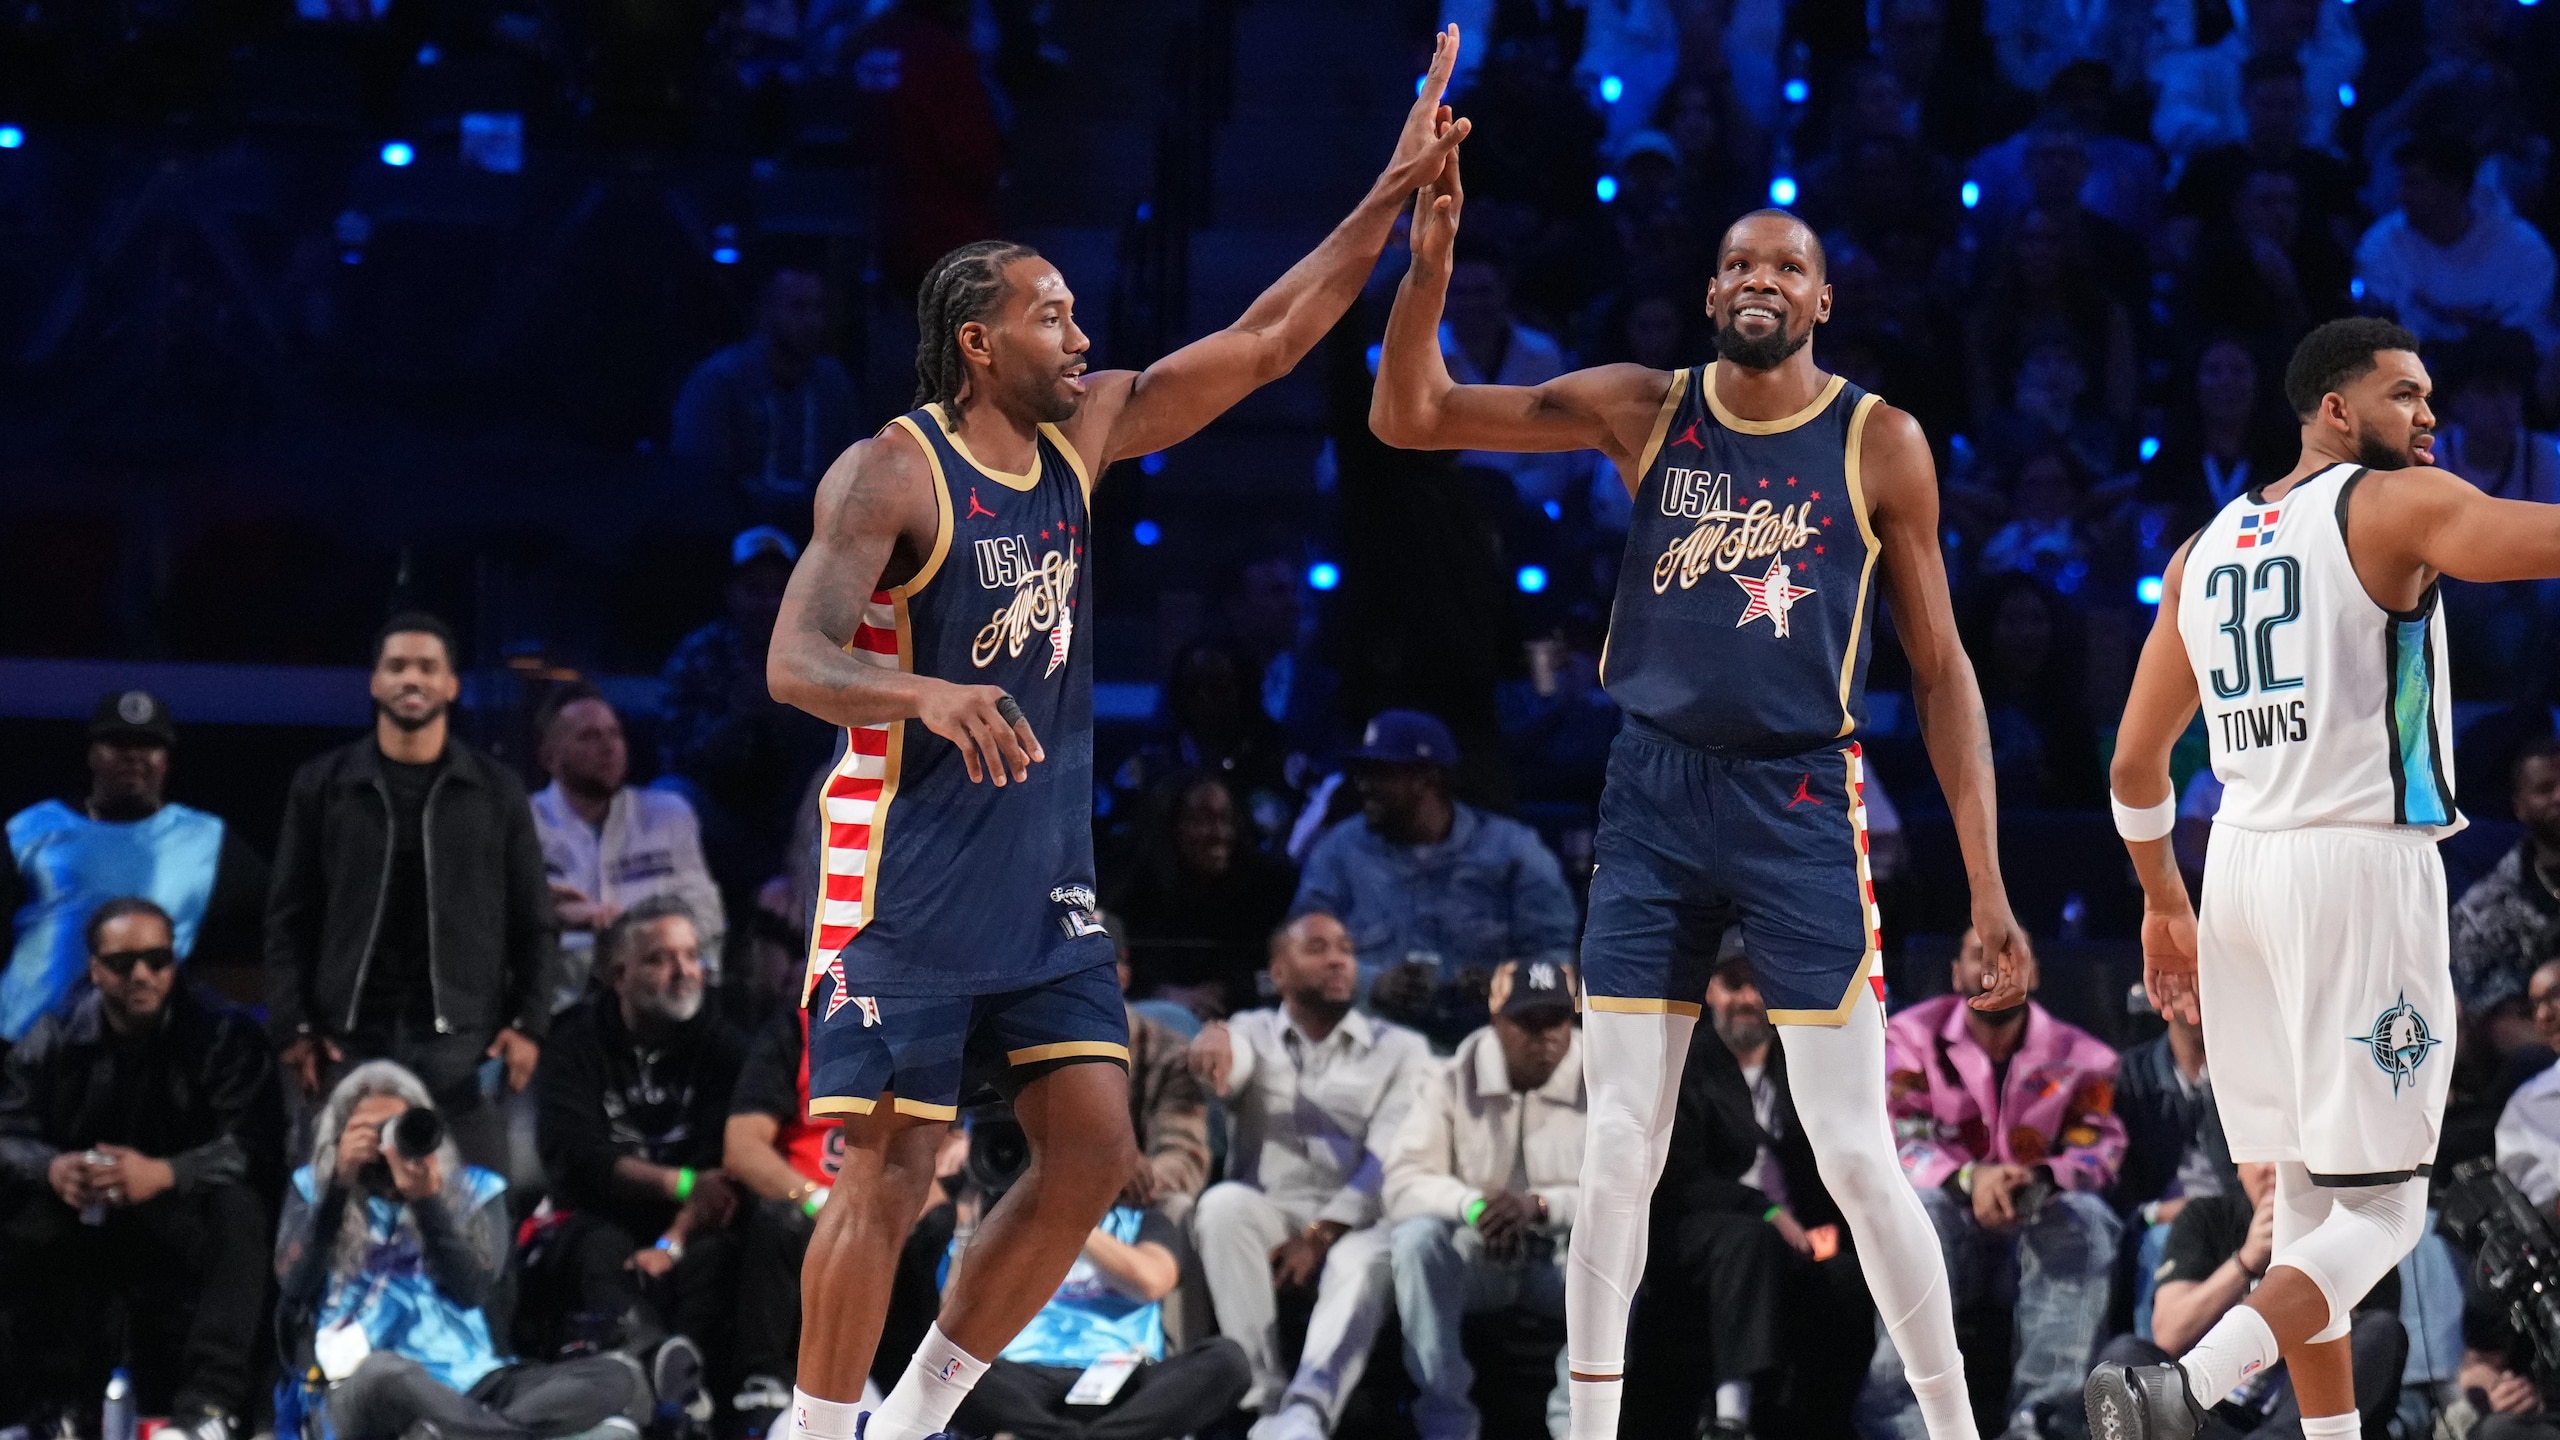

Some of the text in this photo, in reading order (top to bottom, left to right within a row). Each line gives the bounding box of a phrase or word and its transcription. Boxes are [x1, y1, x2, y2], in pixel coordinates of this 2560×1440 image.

[1661, 467, 1731, 522] USA
[974, 534, 1034, 589] USA
[1652, 499, 1821, 595] All Stars
[971, 583, 1033, 668] All
[2205, 555, 2305, 701] 32
[2218, 700, 2307, 754] TOWNS
